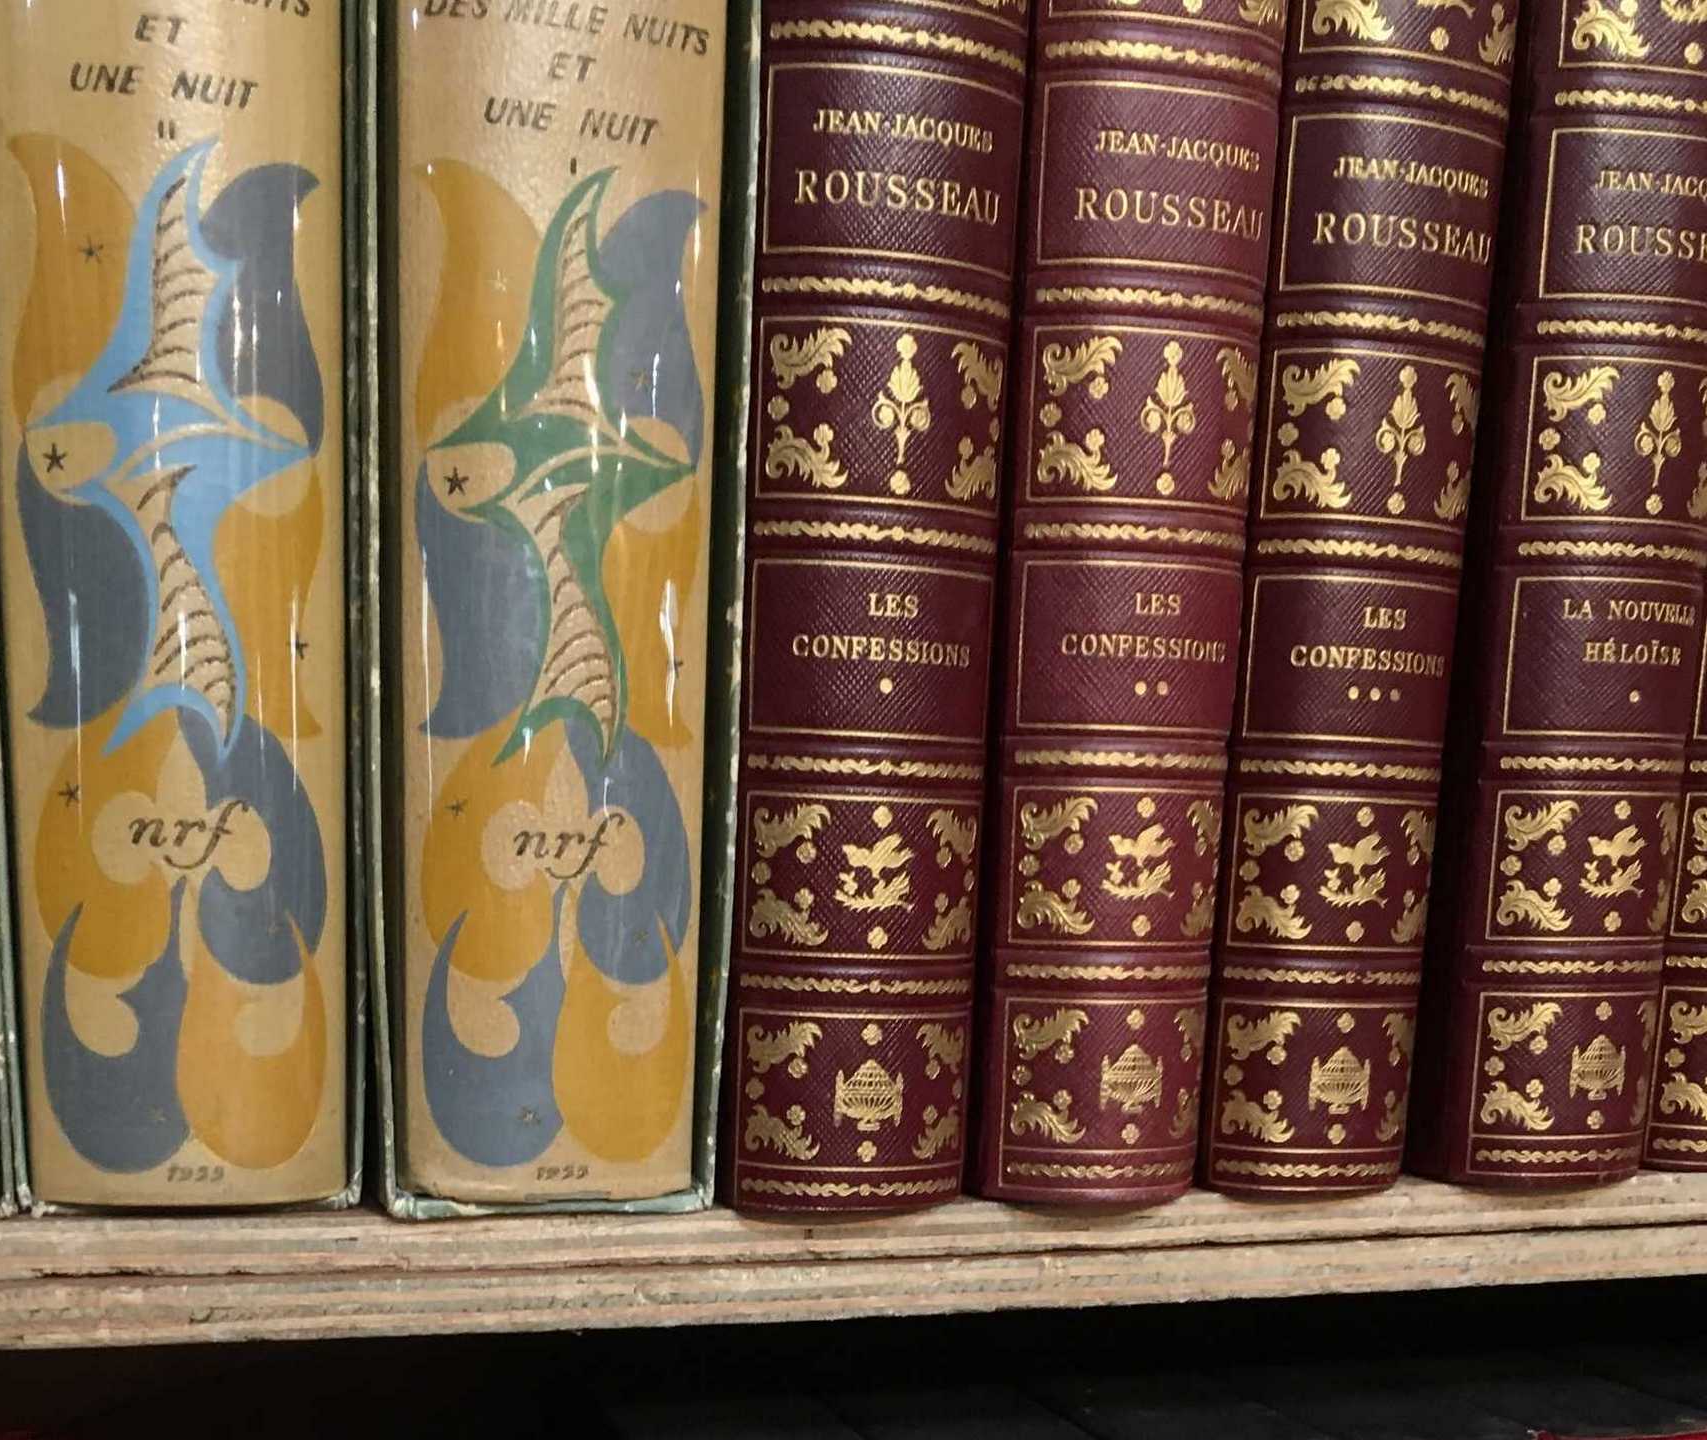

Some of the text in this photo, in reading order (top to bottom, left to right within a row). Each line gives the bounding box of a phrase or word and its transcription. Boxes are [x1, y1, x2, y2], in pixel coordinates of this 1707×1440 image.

[135, 14, 188, 45] ET
[505, 0, 609, 34] MILLE
[623, 13, 709, 55] NUITS
[549, 52, 597, 83] ET
[70, 63, 259, 110] UNE NUIT
[484, 97, 658, 147] UNE NUIT
[794, 168, 1001, 226] ROUSSEAU
[1074, 186, 1265, 241] ROUSSEAU
[1312, 211, 1491, 264] ROUSSEAU
[868, 592, 919, 619] LES
[1135, 592, 1181, 617] LES
[1364, 606, 1407, 631] LES
[1561, 598, 1593, 621] LA
[792, 634, 971, 668] CONFESSIONS
[1061, 633, 1226, 663] CONFESSIONS
[1290, 644, 1446, 679] CONFESSIONS
[1583, 637, 1682, 667] HÉLOÏSE
[129, 799, 252, 873] nrf
[513, 813, 629, 881] nrf
